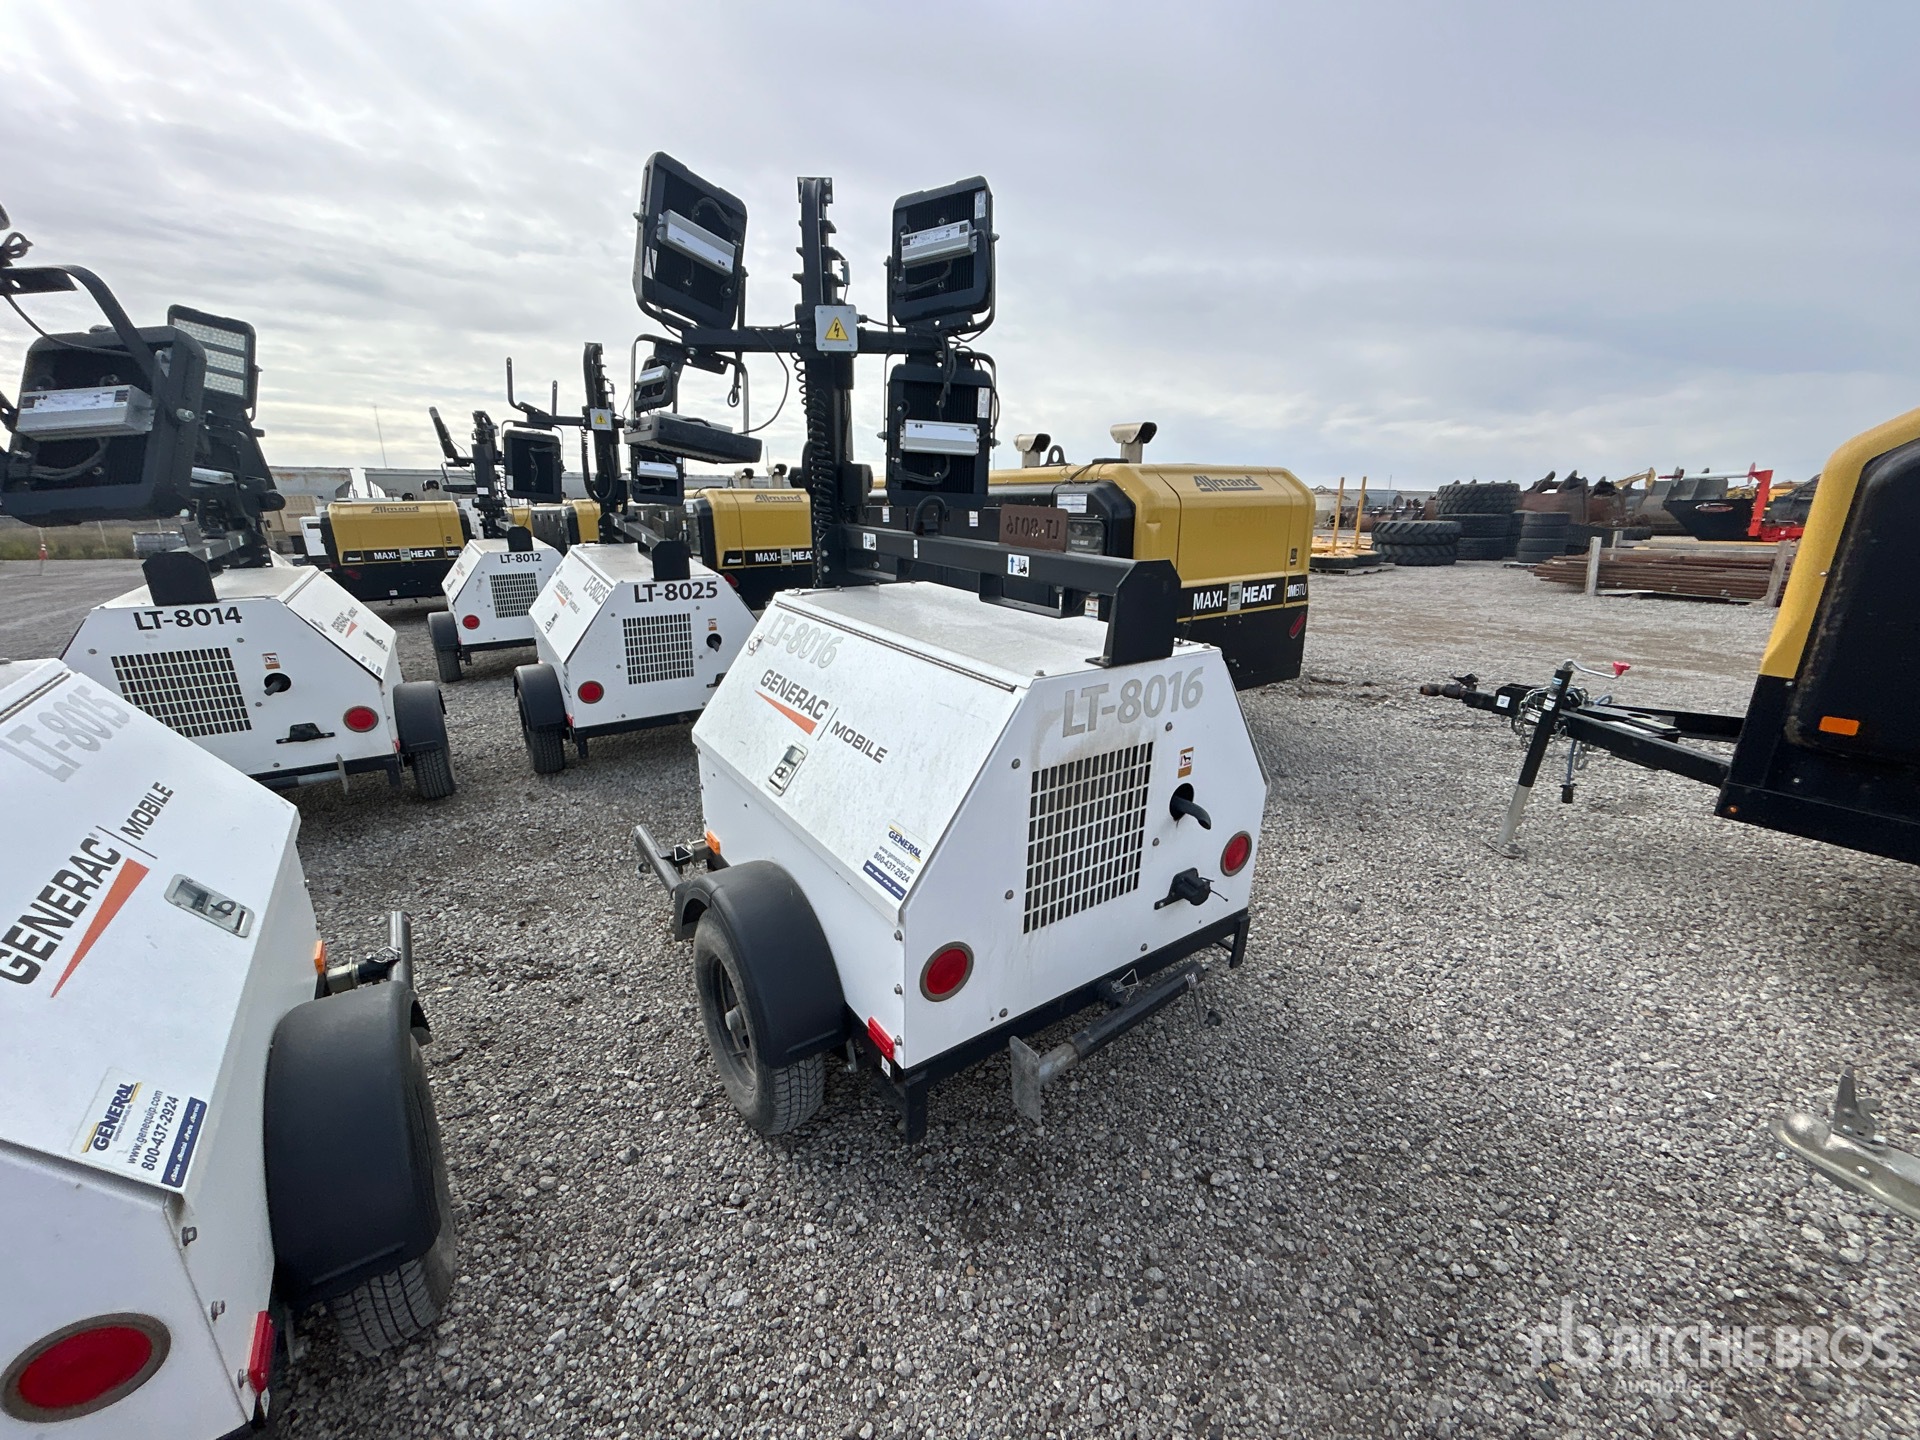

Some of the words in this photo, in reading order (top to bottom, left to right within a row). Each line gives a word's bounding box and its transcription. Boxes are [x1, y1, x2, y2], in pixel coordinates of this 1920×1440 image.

[755, 494, 802, 502] Allmand
[1193, 475, 1260, 491] Allmand
[371, 505, 420, 513] Allmand
[410, 549, 436, 558] HEAT
[500, 553, 542, 564] LT-8012
[792, 550, 813, 561] HEA
[634, 581, 718, 603] LT-8025
[1241, 583, 1276, 604] HEAT
[133, 607, 243, 631] LT-8014
[763, 613, 845, 669] LT-8016
[760, 669, 830, 721] GENERAC
[1063, 666, 1204, 738] LT-8016
[0, 685, 131, 783] LT-8015
[830, 720, 888, 764] MOBILE
[120, 781, 174, 841] MOBILE
[888, 830, 922, 859] GENERAL
[873, 851, 911, 883] 800-437-2924
[0, 836, 122, 985] GENERAC
[93, 1083, 135, 1151] GENERAL
[127, 1090, 163, 1164] www.genequip.com
[141, 1095, 179, 1171] 800-437-2924
